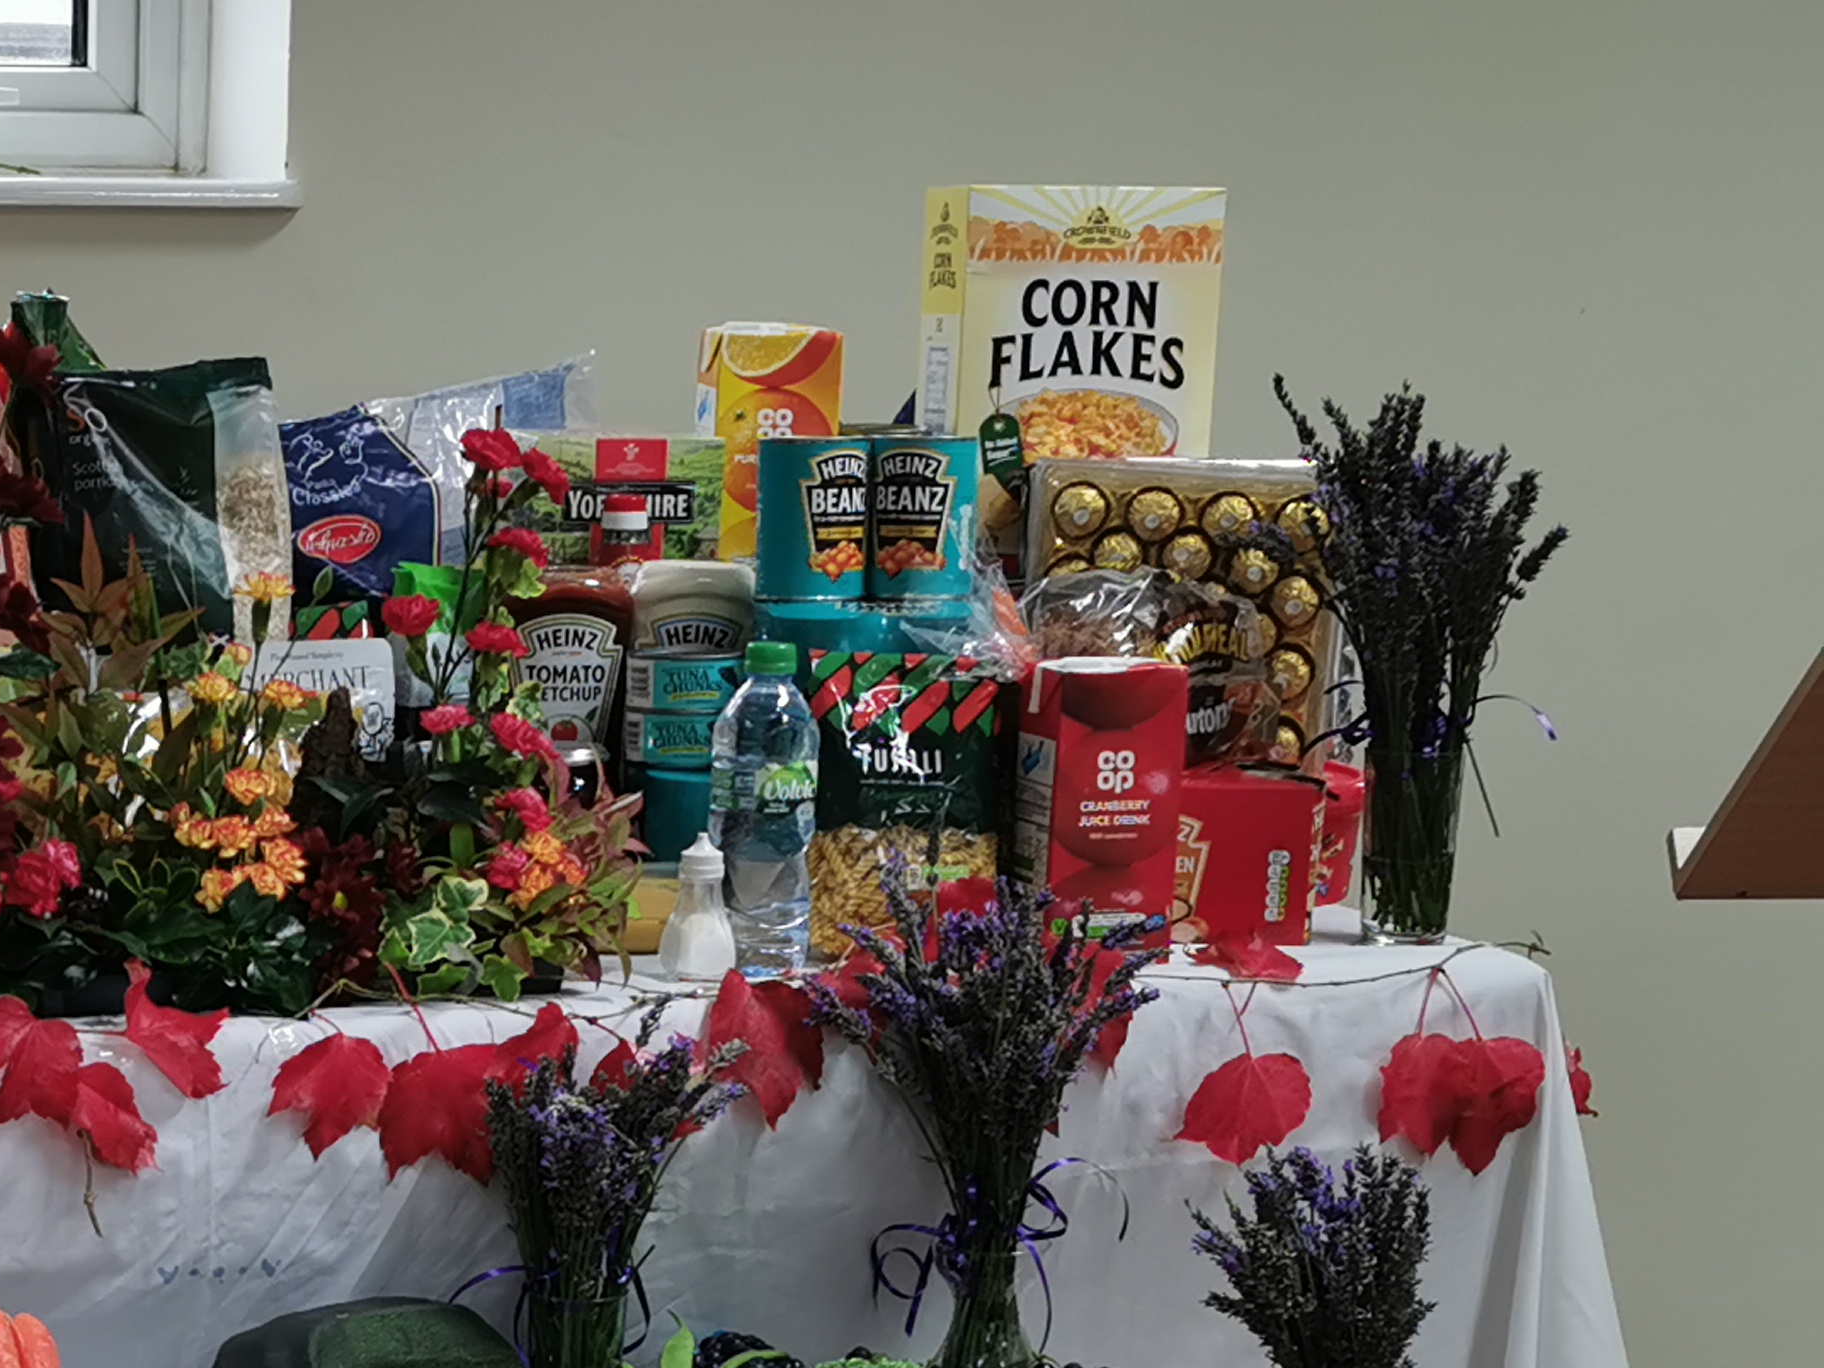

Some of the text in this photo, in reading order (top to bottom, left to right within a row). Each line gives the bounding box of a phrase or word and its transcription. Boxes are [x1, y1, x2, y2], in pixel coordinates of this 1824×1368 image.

[1021, 278, 1159, 329] CORN
[987, 331, 1186, 390] FLAKES
[883, 456, 939, 478] HEINZ
[877, 486, 947, 512] BEANZ
[537, 628, 598, 651] HEINZ
[665, 624, 730, 649] HEINZ
[526, 664, 606, 685] TOMATO
[667, 669, 711, 683] TUNA
[541, 685, 602, 701] ETCHUP
[764, 780, 816, 801] Volvic
[1079, 800, 1151, 812] CRANBERRY
[1079, 814, 1151, 827] JUICE DRINK
